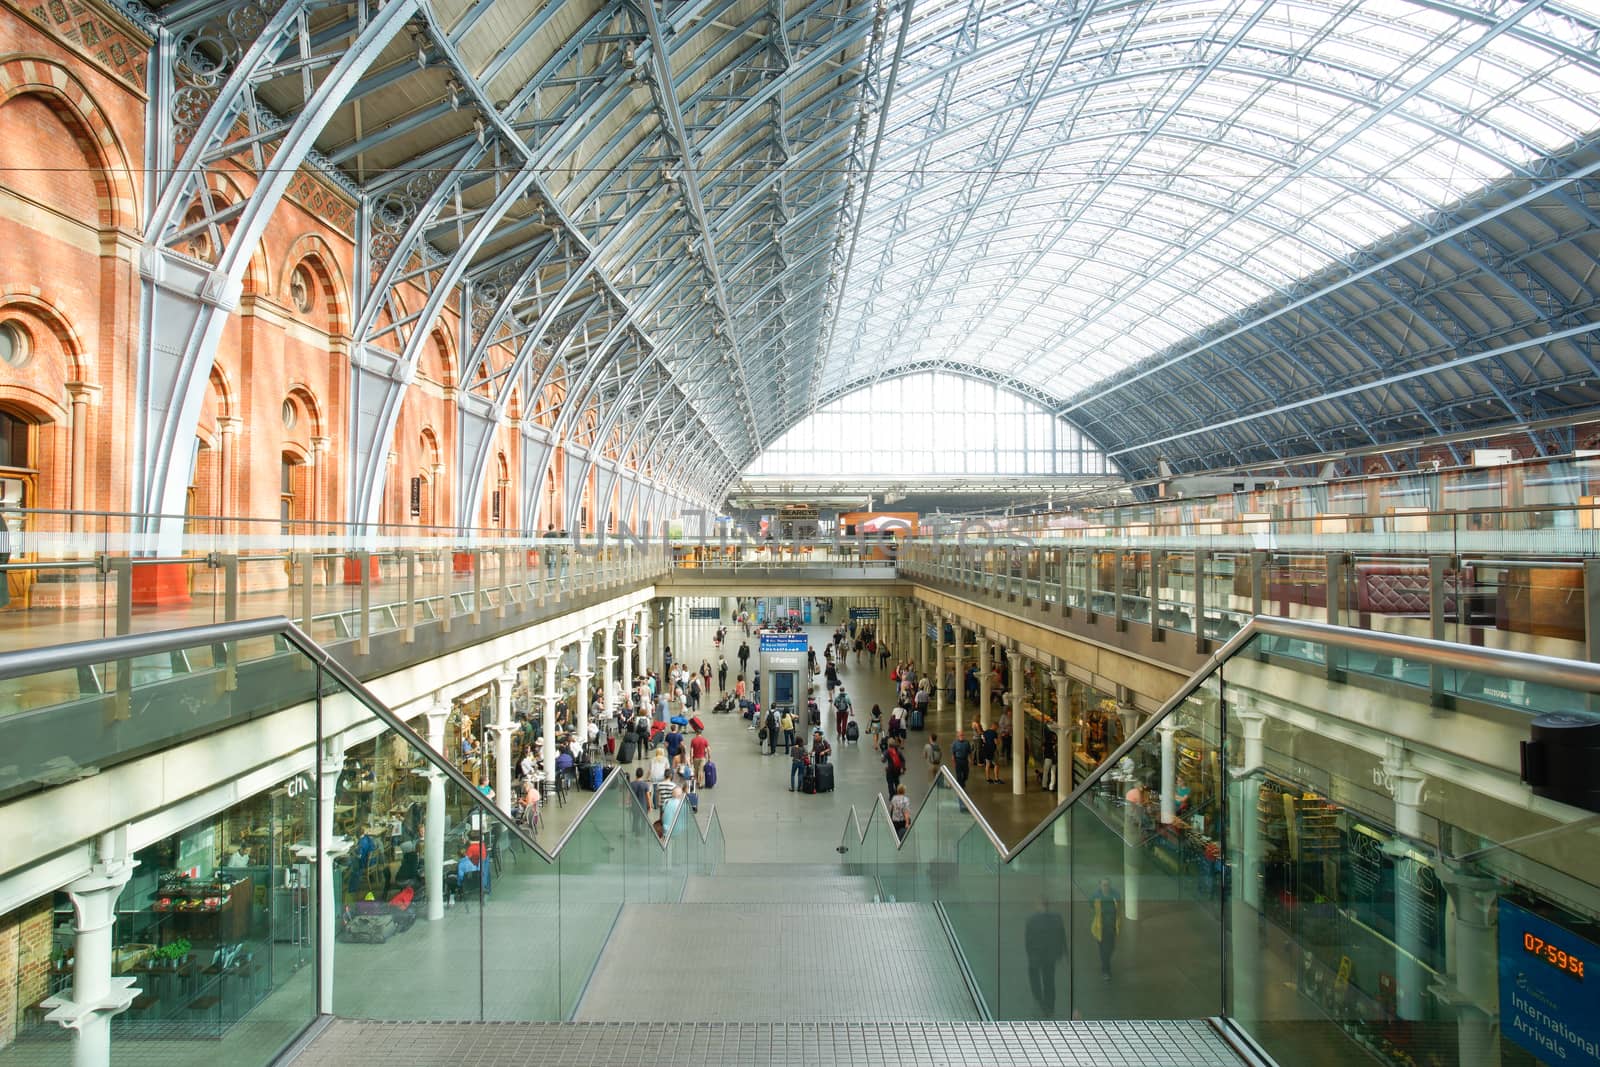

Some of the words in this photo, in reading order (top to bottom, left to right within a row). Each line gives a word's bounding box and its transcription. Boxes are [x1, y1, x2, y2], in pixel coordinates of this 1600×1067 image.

[1349, 831, 1382, 862] M&S
[1512, 992, 1600, 1060] International
[1513, 1015, 1567, 1059] Arrivals
